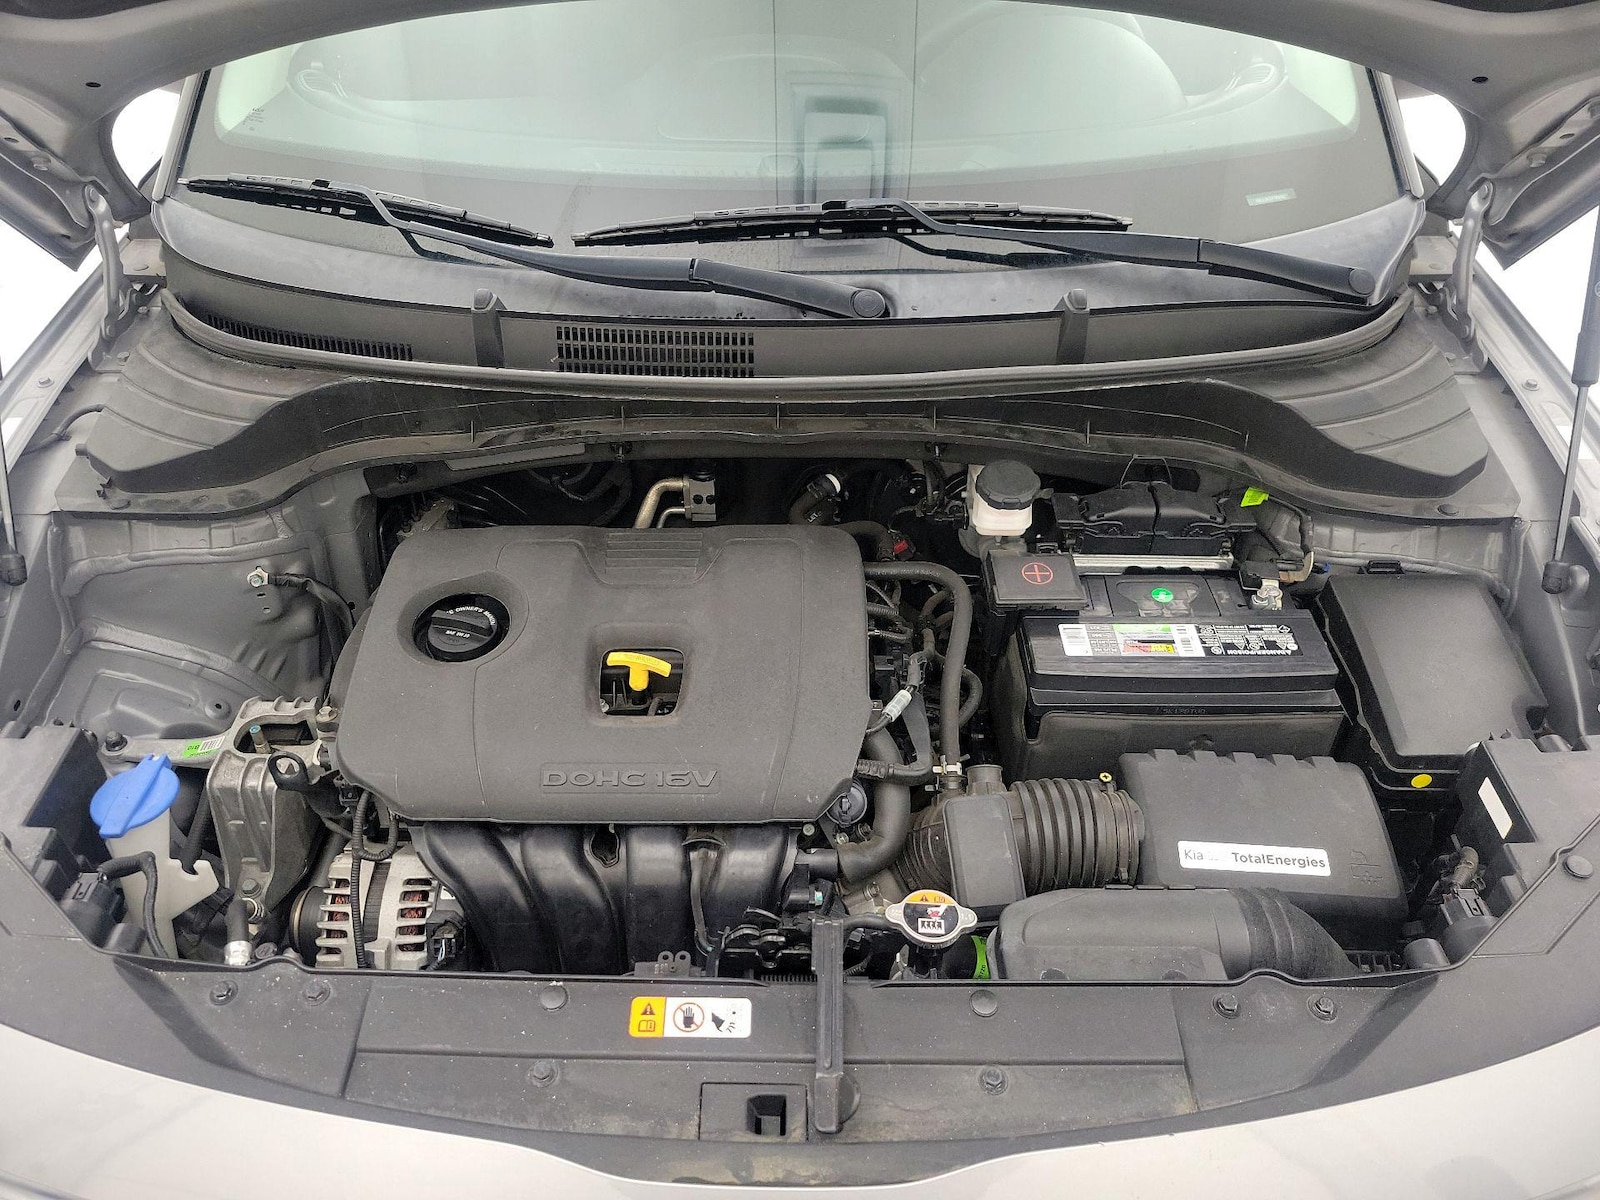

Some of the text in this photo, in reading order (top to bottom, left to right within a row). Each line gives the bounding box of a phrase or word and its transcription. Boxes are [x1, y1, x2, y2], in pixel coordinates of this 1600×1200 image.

[543, 770, 718, 787] DOHC 16V
[1184, 849, 1204, 861] Kia
[1231, 852, 1327, 869] TotalEnergies
